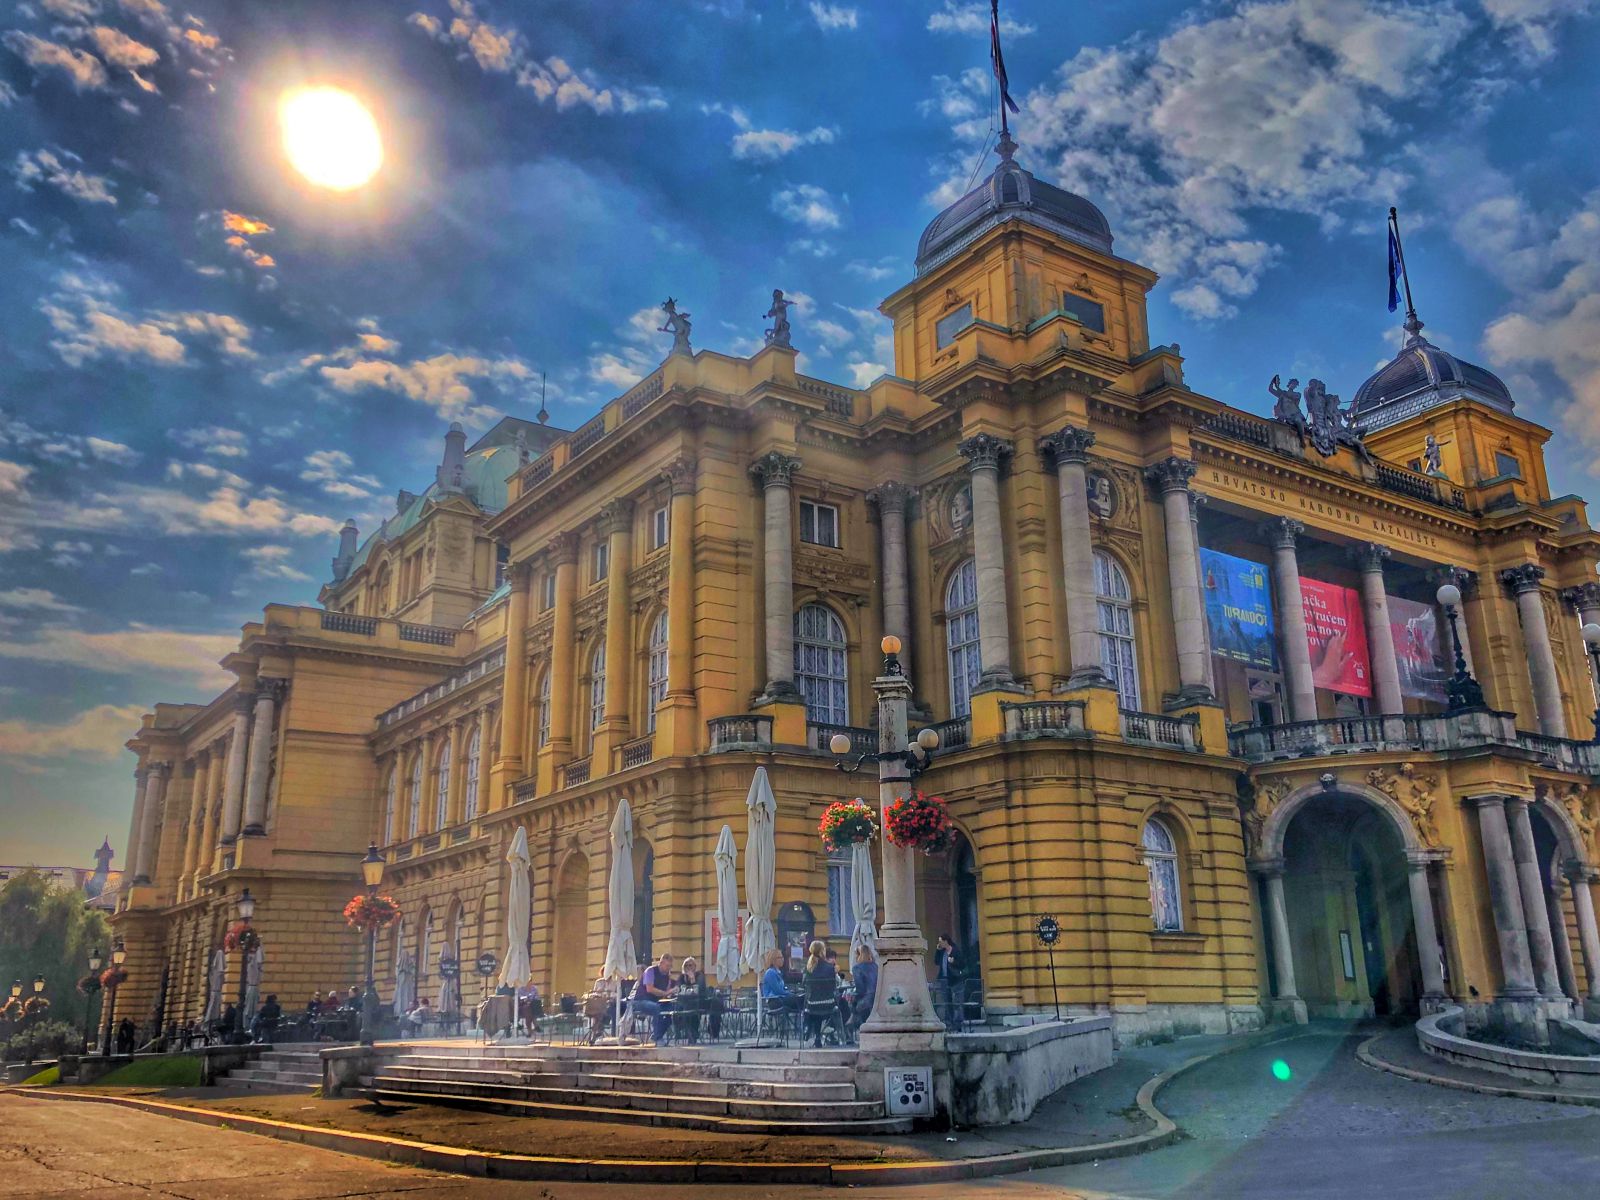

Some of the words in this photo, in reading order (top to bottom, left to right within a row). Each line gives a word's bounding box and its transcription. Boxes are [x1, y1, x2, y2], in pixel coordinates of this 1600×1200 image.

[1212, 472, 1285, 502] HRVATSKO
[1300, 499, 1360, 525] NARODNO
[1302, 594, 1327, 609] ačka
[1222, 603, 1268, 627] TURANDOT
